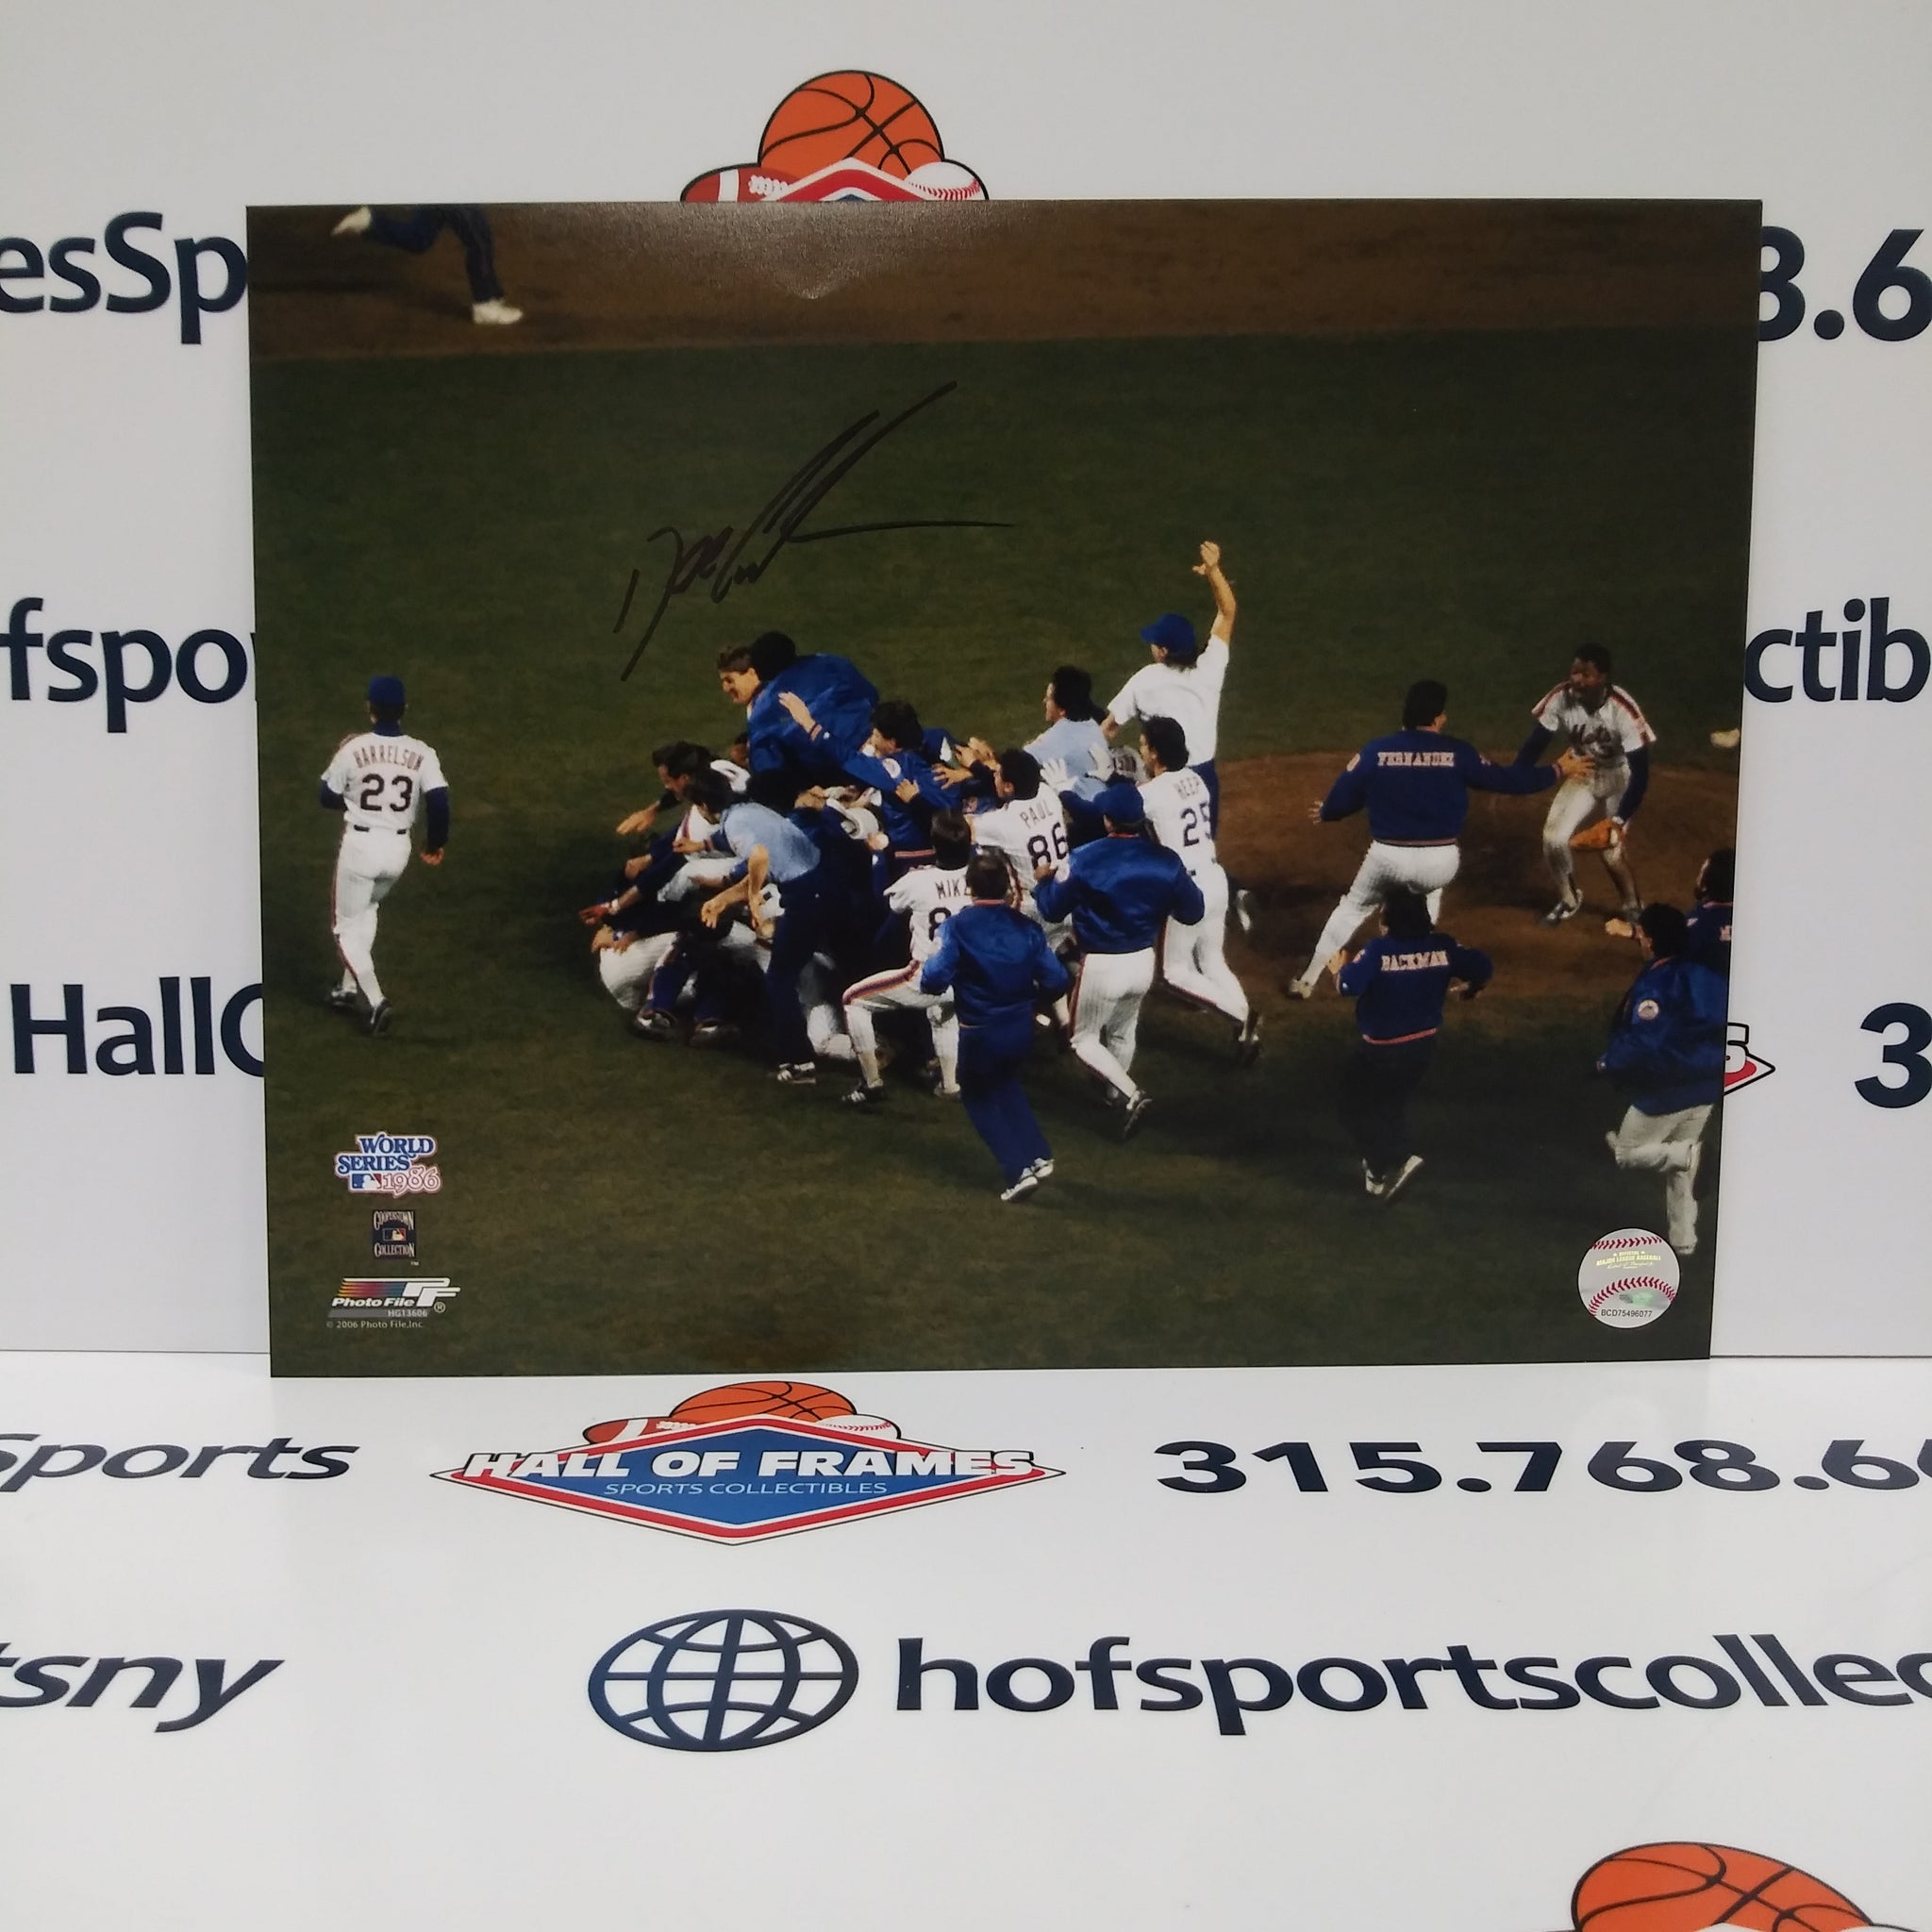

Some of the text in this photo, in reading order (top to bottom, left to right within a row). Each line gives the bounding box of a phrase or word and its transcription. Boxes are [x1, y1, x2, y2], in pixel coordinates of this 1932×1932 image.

[1744, 596, 1931, 703] ctib
[0, 597, 255, 733] fspo
[353, 745, 424, 772] HARRELSON
[359, 773, 412, 812] 23
[1020, 800, 1053, 827] PAUL
[1027, 822, 1068, 870] 86
[935, 878, 972, 899] MIK
[1380, 950, 1450, 972] BACKMAN
[1855, 1002, 1932, 1108] 3
[359, 1133, 435, 1158] WORLD
[337, 1155, 410, 1174] SERIES
[383, 1166, 441, 1197] 1986
[374, 1210, 415, 1230] COOPERSTOWN
[374, 1242, 416, 1257] COLLECTION
[331, 1297, 415, 1307] Photo File
[387, 1308, 428, 1318] HG13606
[1600, 1308, 1653, 1318] BCD75496077
[463, 1449, 1035, 1478] HALL OF FRAMES
[1153, 1439, 1932, 1493] 315.768.6
[604, 1482, 889, 1494] SPORTS COLLECTIBLES
